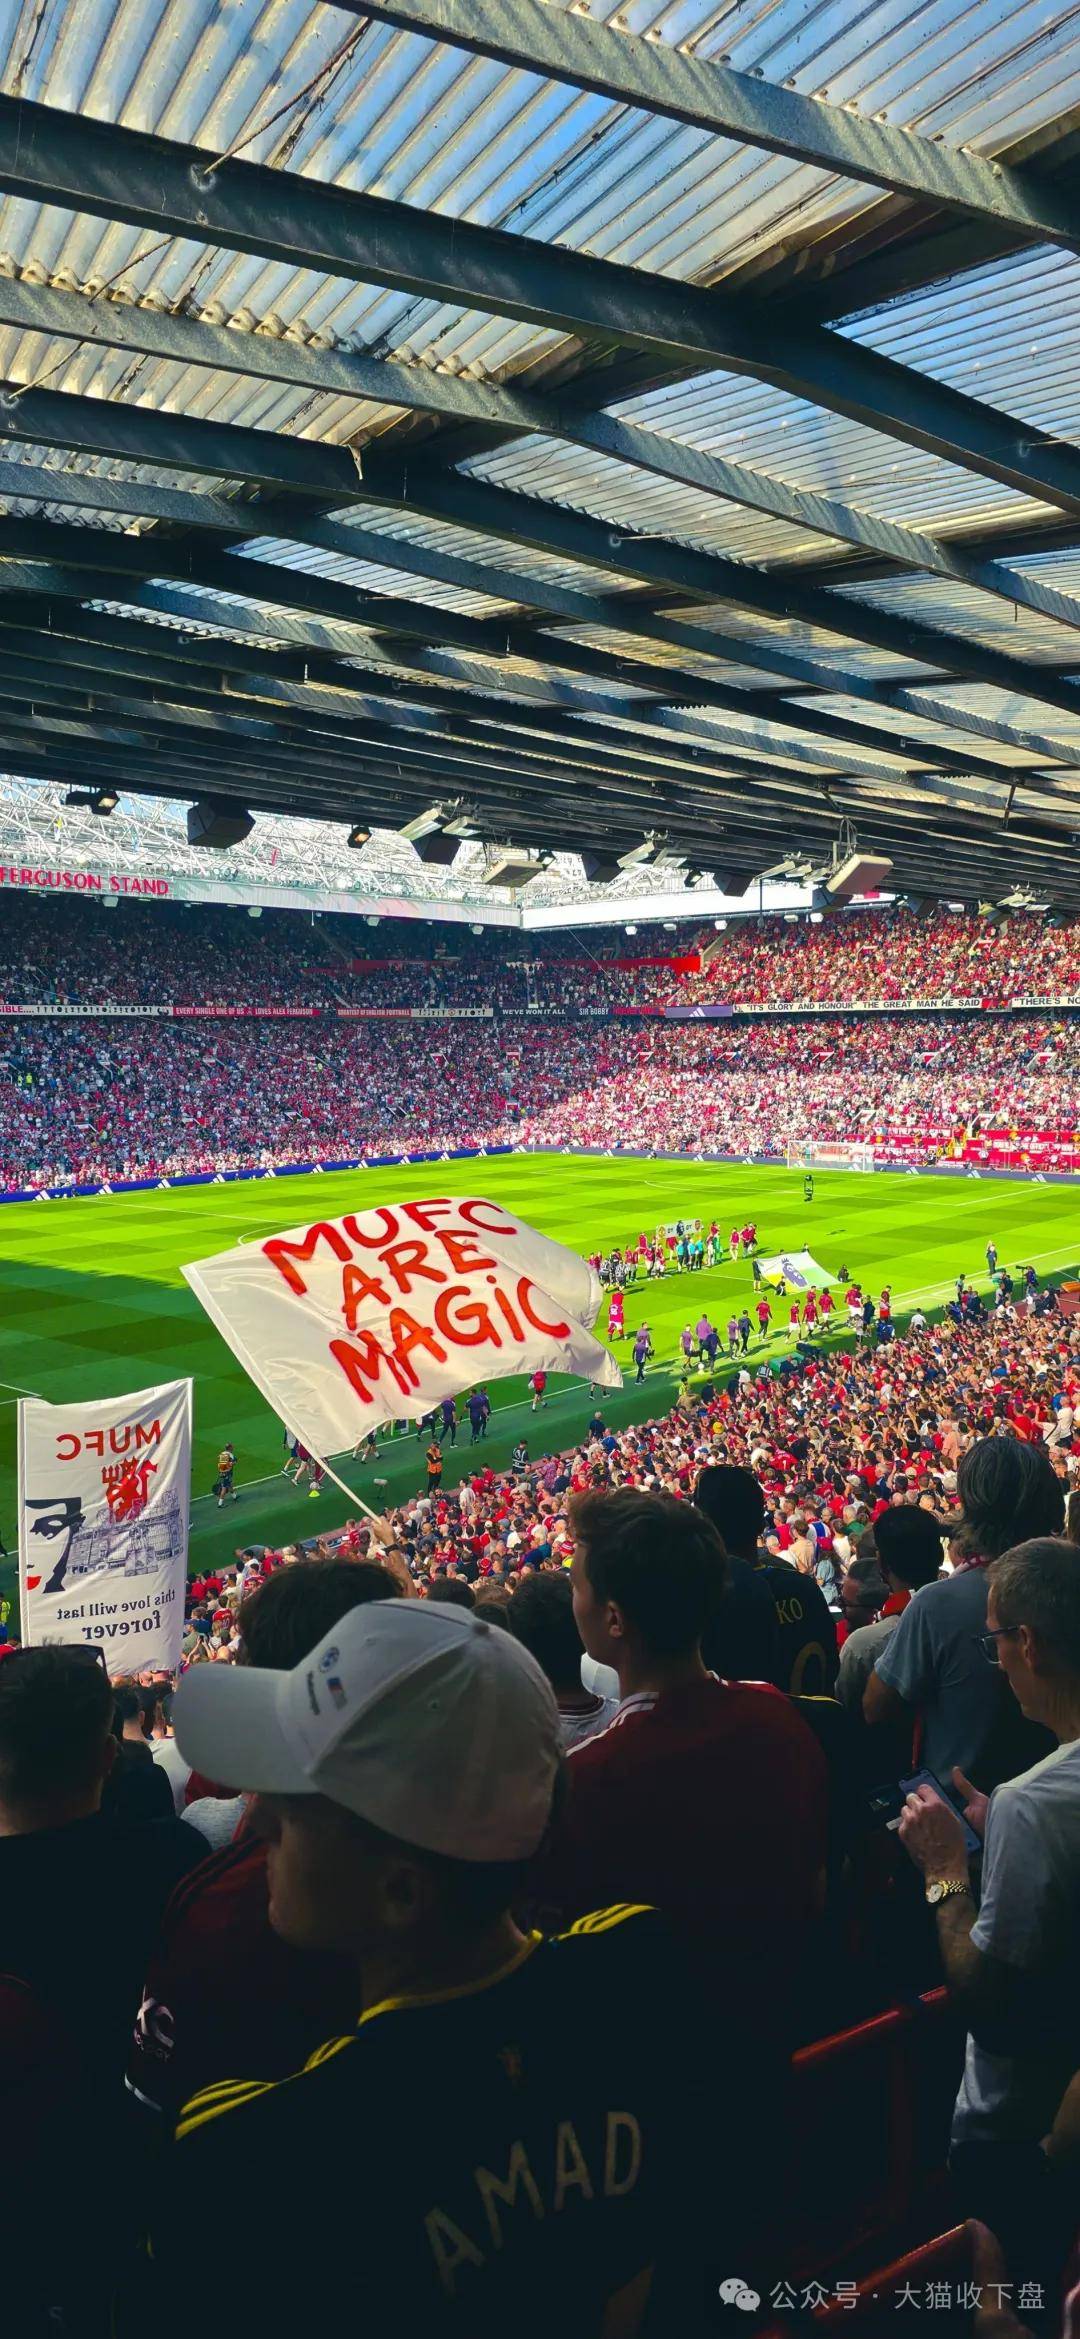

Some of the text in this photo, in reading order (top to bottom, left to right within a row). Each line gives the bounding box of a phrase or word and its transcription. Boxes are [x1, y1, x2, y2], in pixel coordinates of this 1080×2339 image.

[0, 867, 169, 895] FERGUSON STAND
[175, 1007, 194, 1015] EVERY
[194, 1007, 215, 1015] SINGLE
[578, 1007, 589, 1016] SIR
[590, 1007, 609, 1016] BOBBY
[797, 1002, 815, 1010] AND
[862, 1001, 880, 1009] THE
[883, 1000, 912, 1008] GREAT
[916, 1000, 938, 1008] MAN
[941, 999, 958, 1007] HE
[958, 998, 980, 1007] SAID
[262, 1197, 518, 1297] MUFC
[340, 1229, 499, 1332] ARE
[423, 2110, 642, 2300] AMAD
